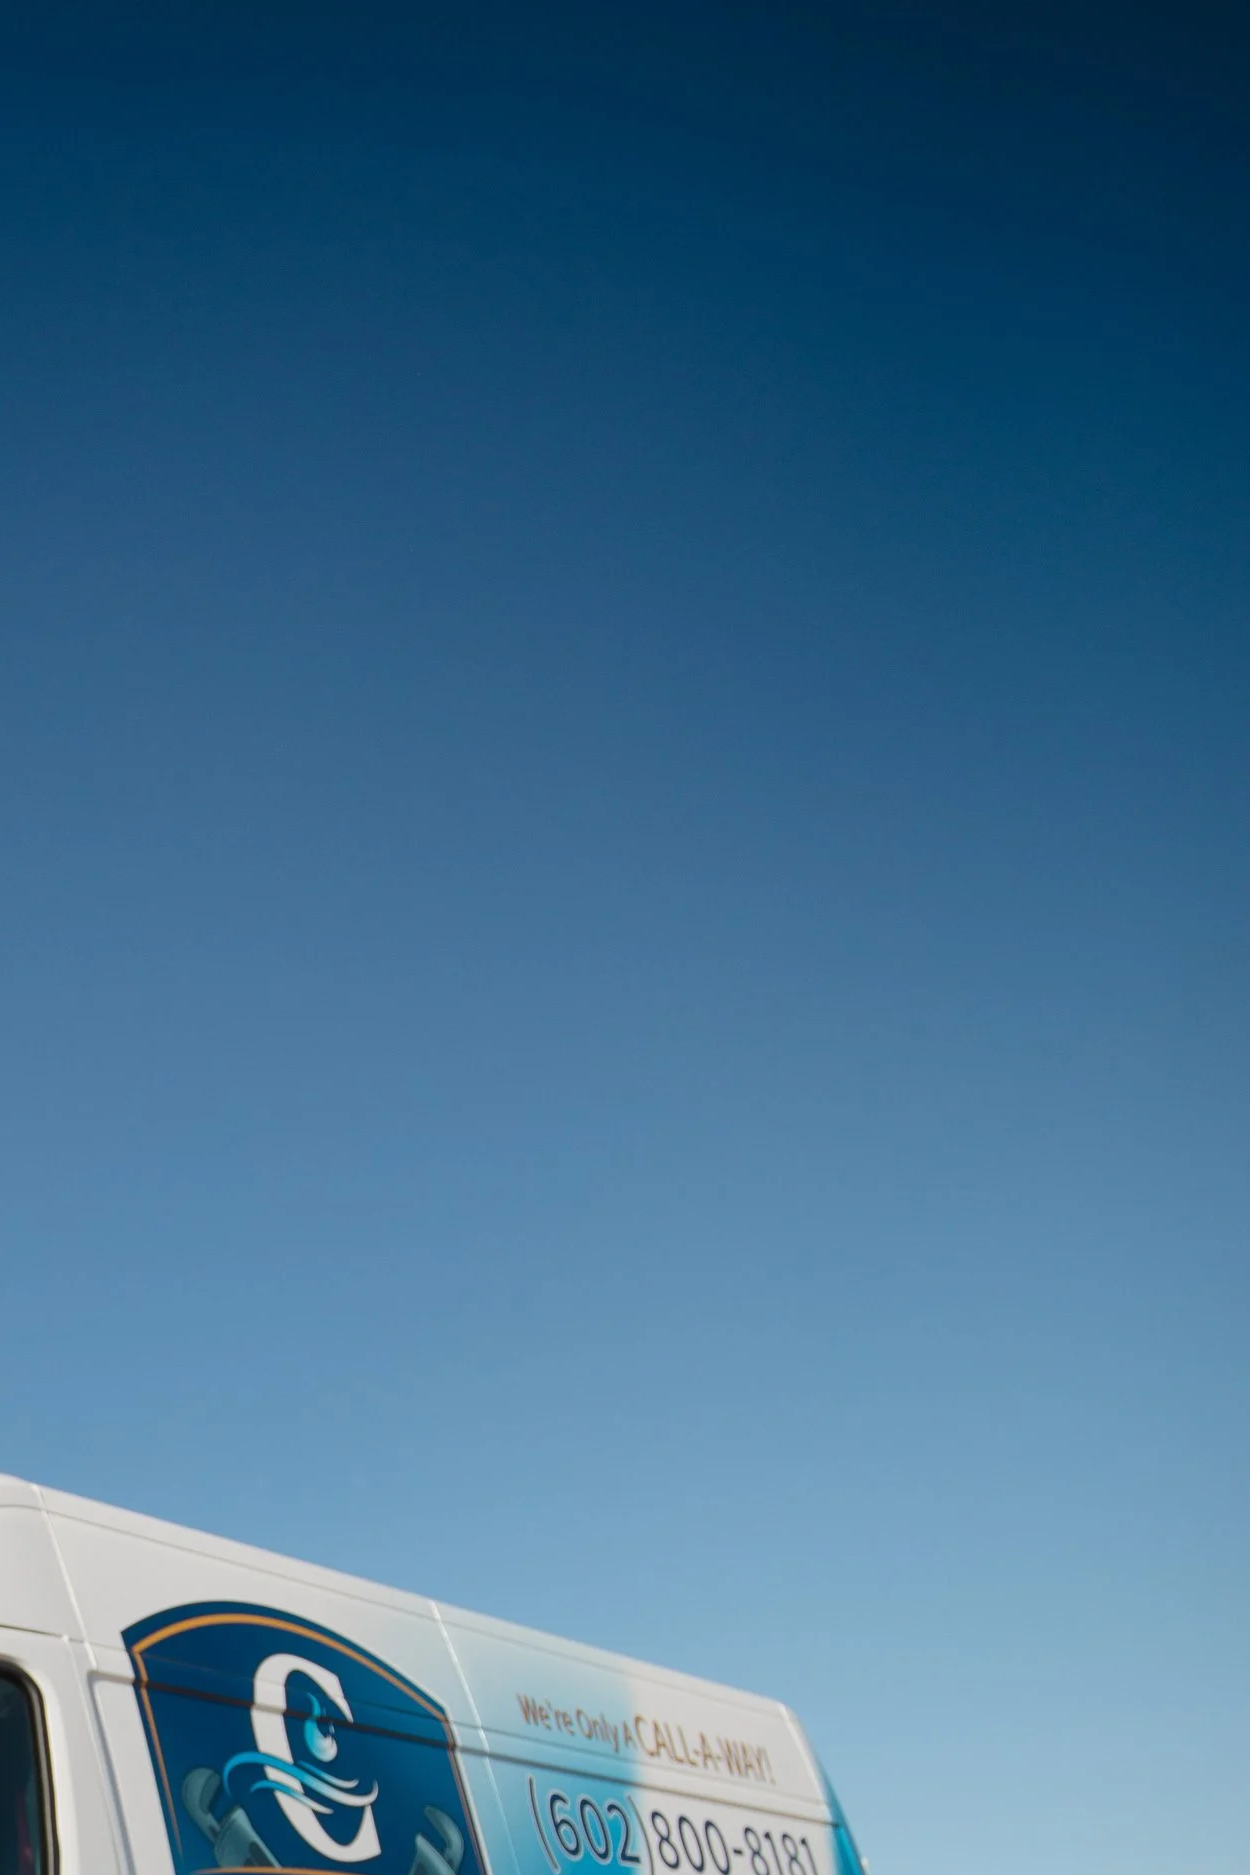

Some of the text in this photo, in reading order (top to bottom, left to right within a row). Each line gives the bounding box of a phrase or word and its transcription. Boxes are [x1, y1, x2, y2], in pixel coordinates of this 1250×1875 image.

[516, 1693, 777, 1786] We're Only A CALL-A-WAY!
